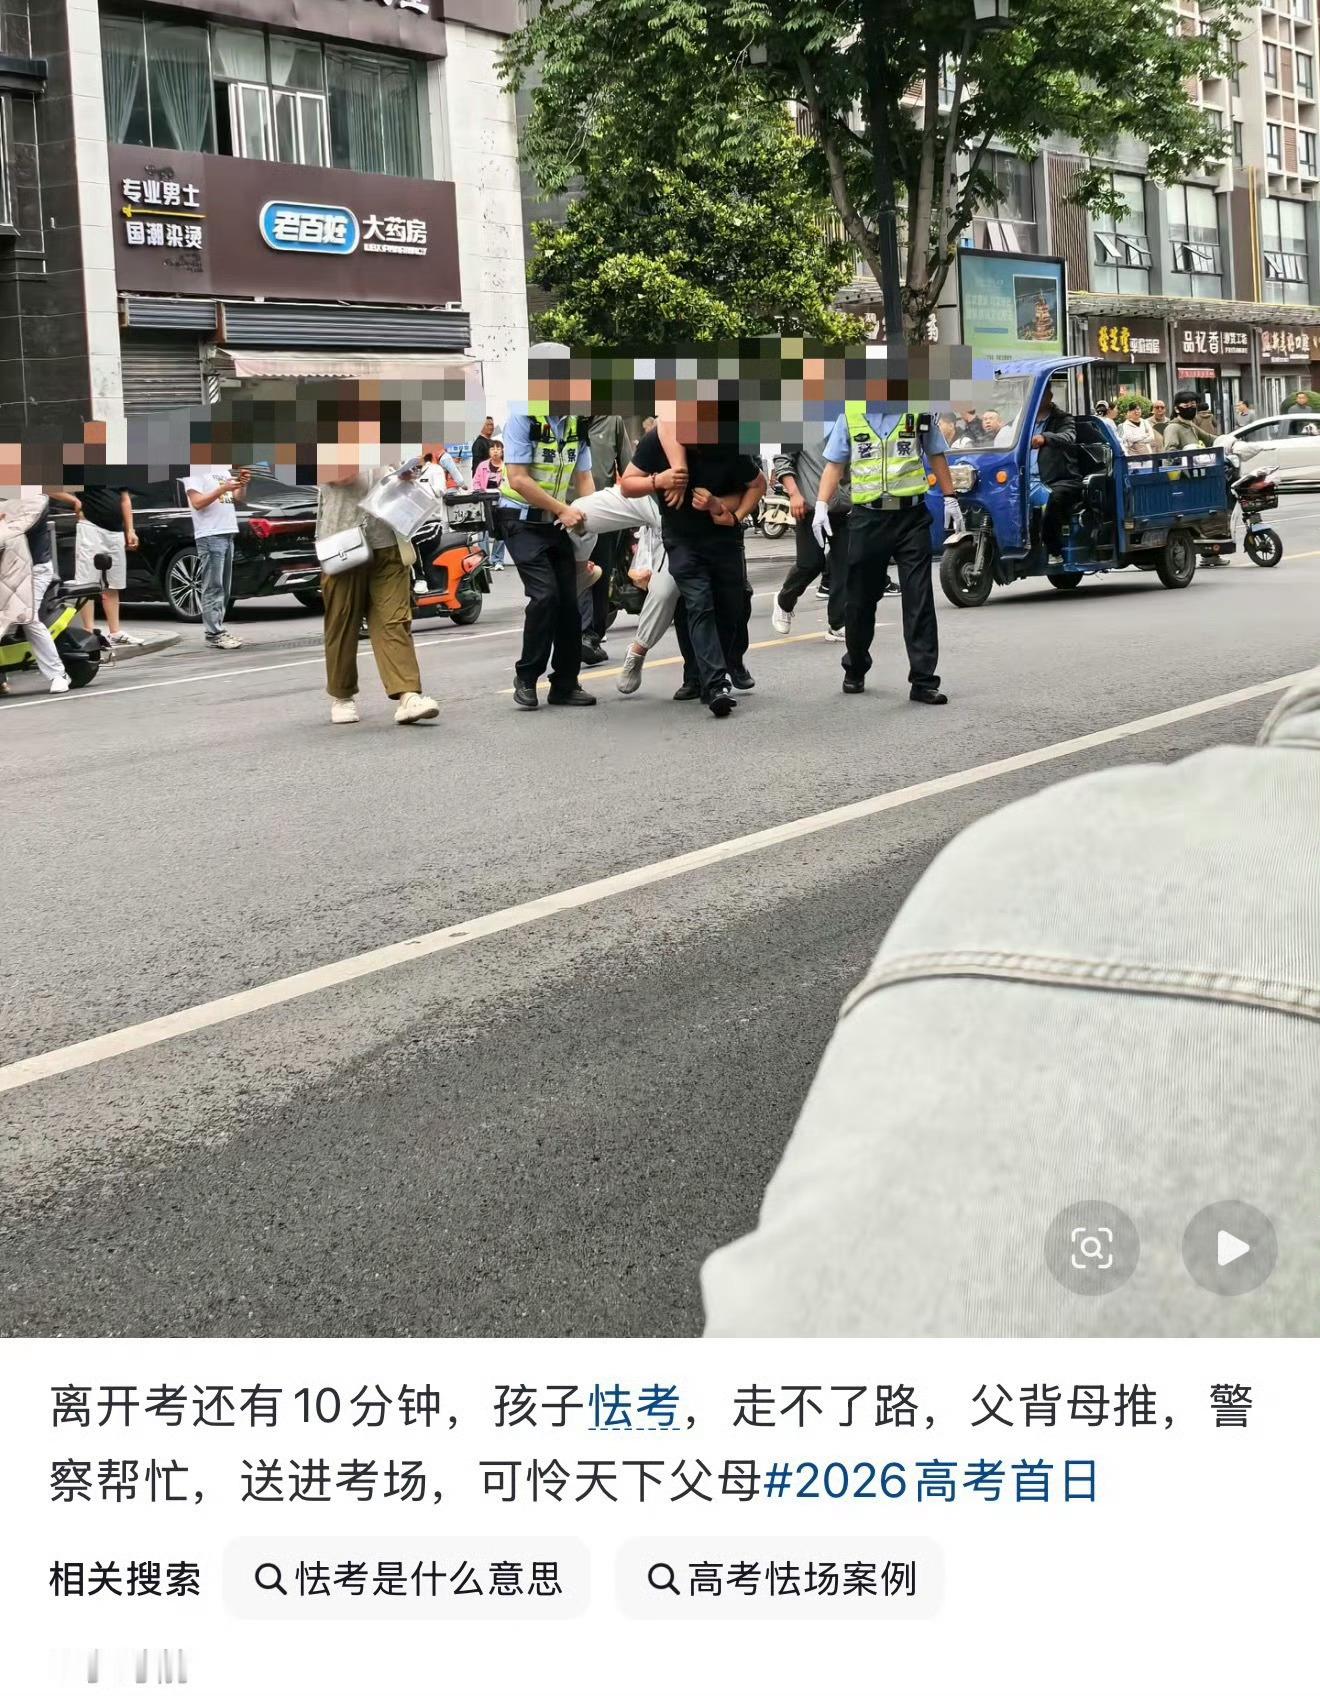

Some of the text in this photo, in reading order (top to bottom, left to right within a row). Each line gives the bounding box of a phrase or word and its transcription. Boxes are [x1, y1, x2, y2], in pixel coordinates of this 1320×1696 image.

[122, 178, 200, 207] 专业男士
[126, 221, 203, 249] 国潮染烫
[1182, 330, 1219, 354] 品忆香
